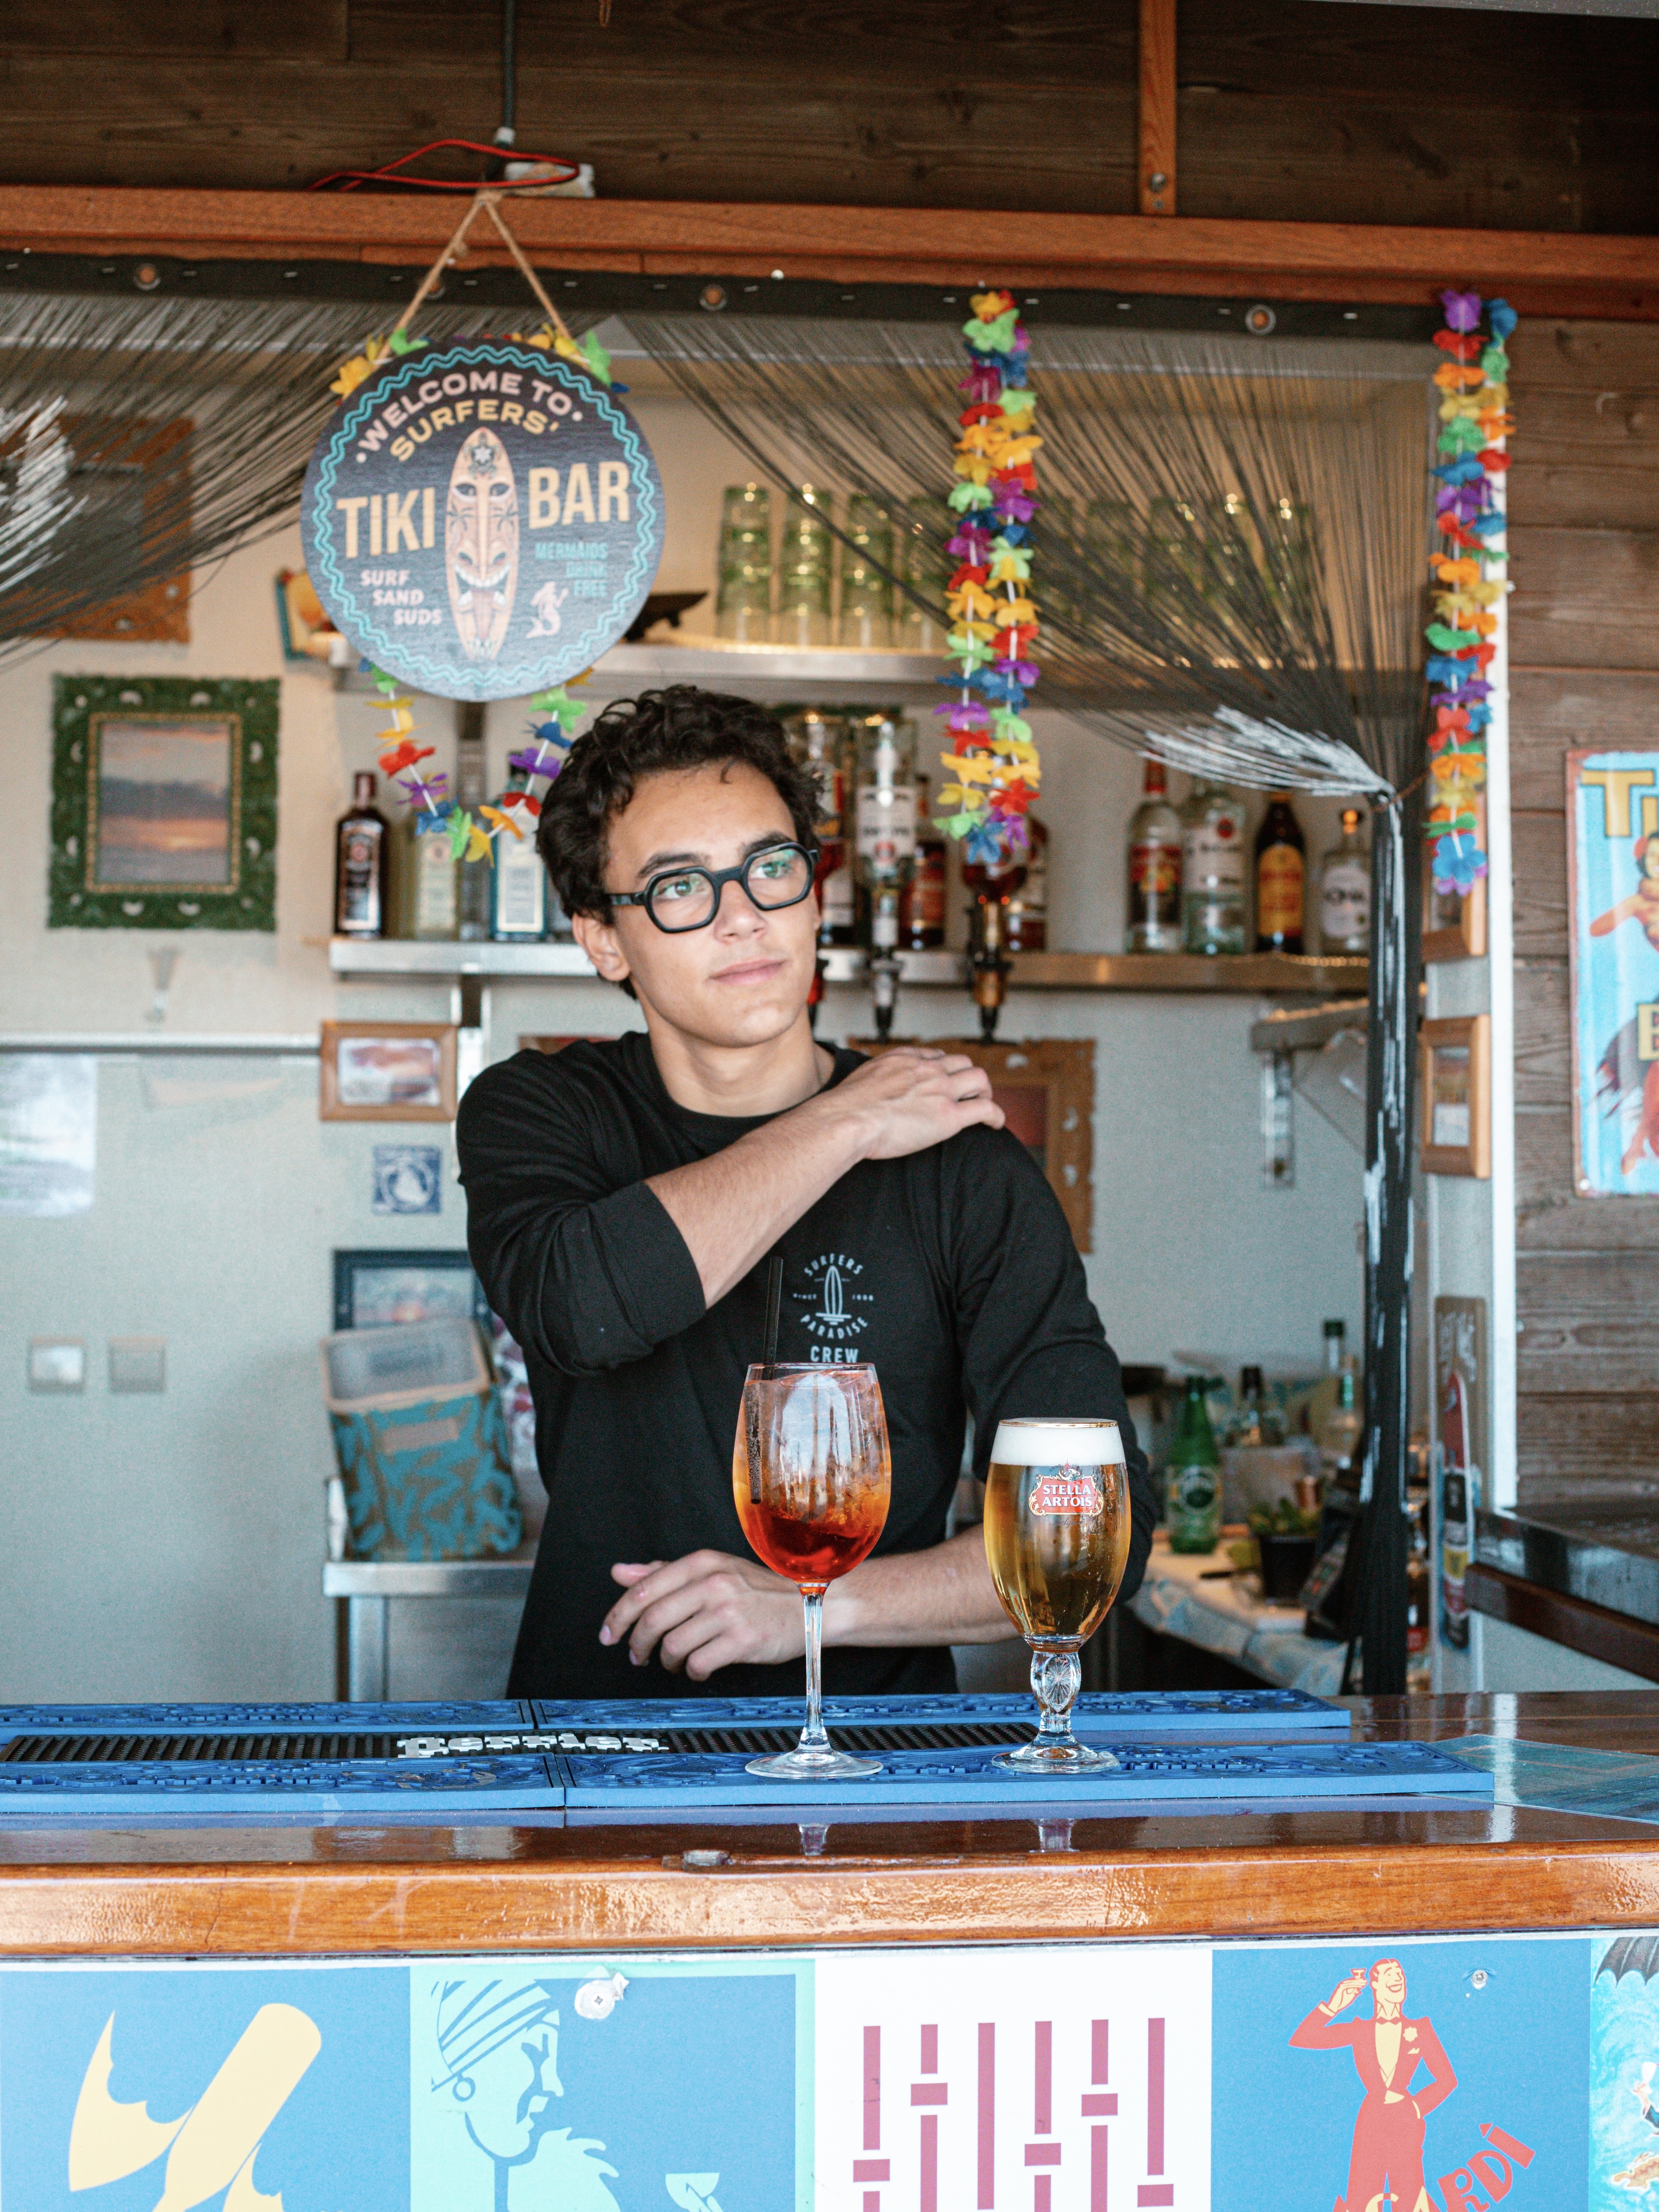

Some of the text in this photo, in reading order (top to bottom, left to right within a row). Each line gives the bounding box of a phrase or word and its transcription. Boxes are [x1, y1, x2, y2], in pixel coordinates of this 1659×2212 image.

[358, 370, 572, 451] WELCOME TO
[390, 398, 559, 461] SURFERS'
[336, 461, 630, 559] TIKI BAR
[534, 542, 608, 560] MERMAIDS
[360, 569, 410, 587] SURF
[573, 579, 608, 597] FREE
[373, 589, 424, 606] SAND
[394, 608, 443, 626] SUDS
[804, 1252, 864, 1277] SURFERS
[800, 1314, 868, 1340] PARADISE
[810, 1345, 858, 1363] CREW
[1042, 1484, 1092, 1496] STELLA
[1042, 1496, 1093, 1507] ARTOIS
